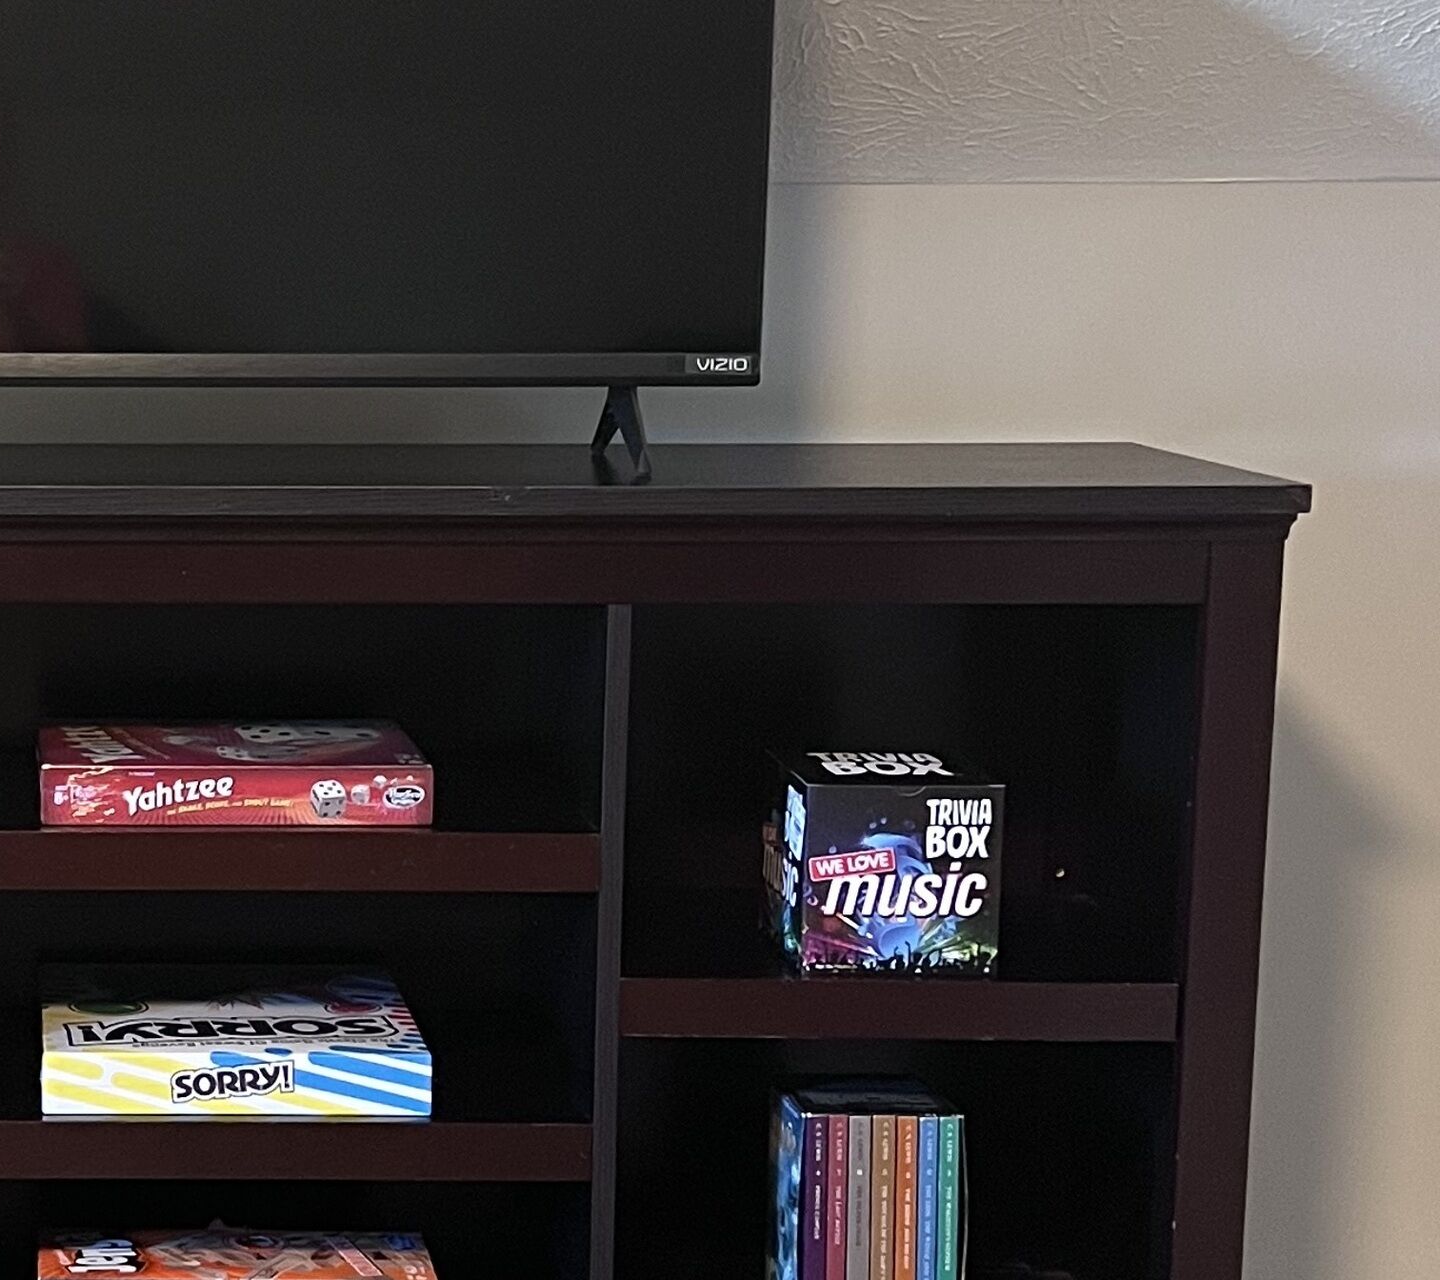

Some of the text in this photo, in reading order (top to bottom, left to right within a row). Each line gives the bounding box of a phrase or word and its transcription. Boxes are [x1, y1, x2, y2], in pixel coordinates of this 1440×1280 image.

[696, 357, 748, 372] VIZIO
[806, 752, 943, 769] TRIVIA
[821, 761, 955, 776] BOX
[122, 776, 234, 816] Yahtzee
[926, 799, 992, 825] TRIVIA
[926, 826, 990, 858] BOX
[815, 852, 889, 877] WE LOVE
[822, 862, 988, 918] music
[74, 1017, 388, 1043] SORRY!
[173, 1065, 292, 1099] SORRY!
